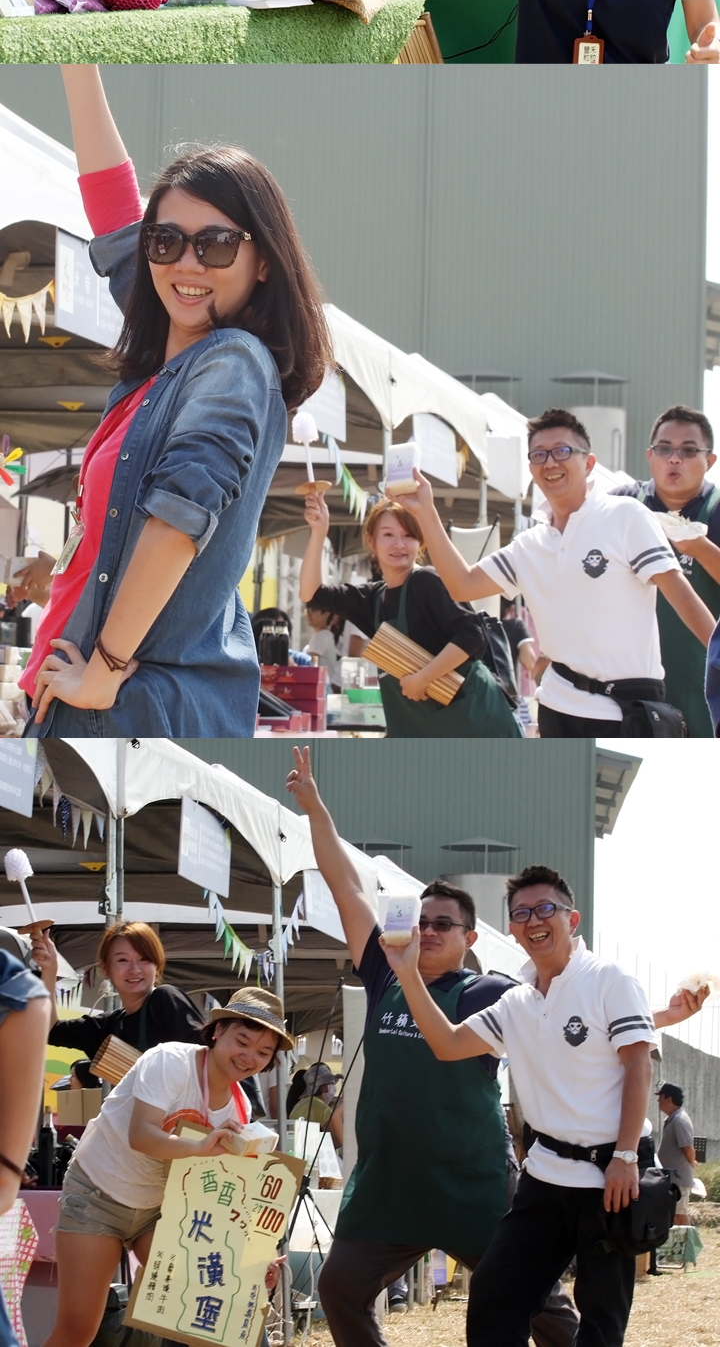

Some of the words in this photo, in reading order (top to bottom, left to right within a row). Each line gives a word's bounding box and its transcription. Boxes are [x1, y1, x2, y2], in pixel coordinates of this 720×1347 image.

[200, 1169, 236, 1206] 香香
[260, 1175, 283, 1201] 60
[256, 1206, 285, 1233] 100
[188, 1210, 226, 1334] 米漢堡
